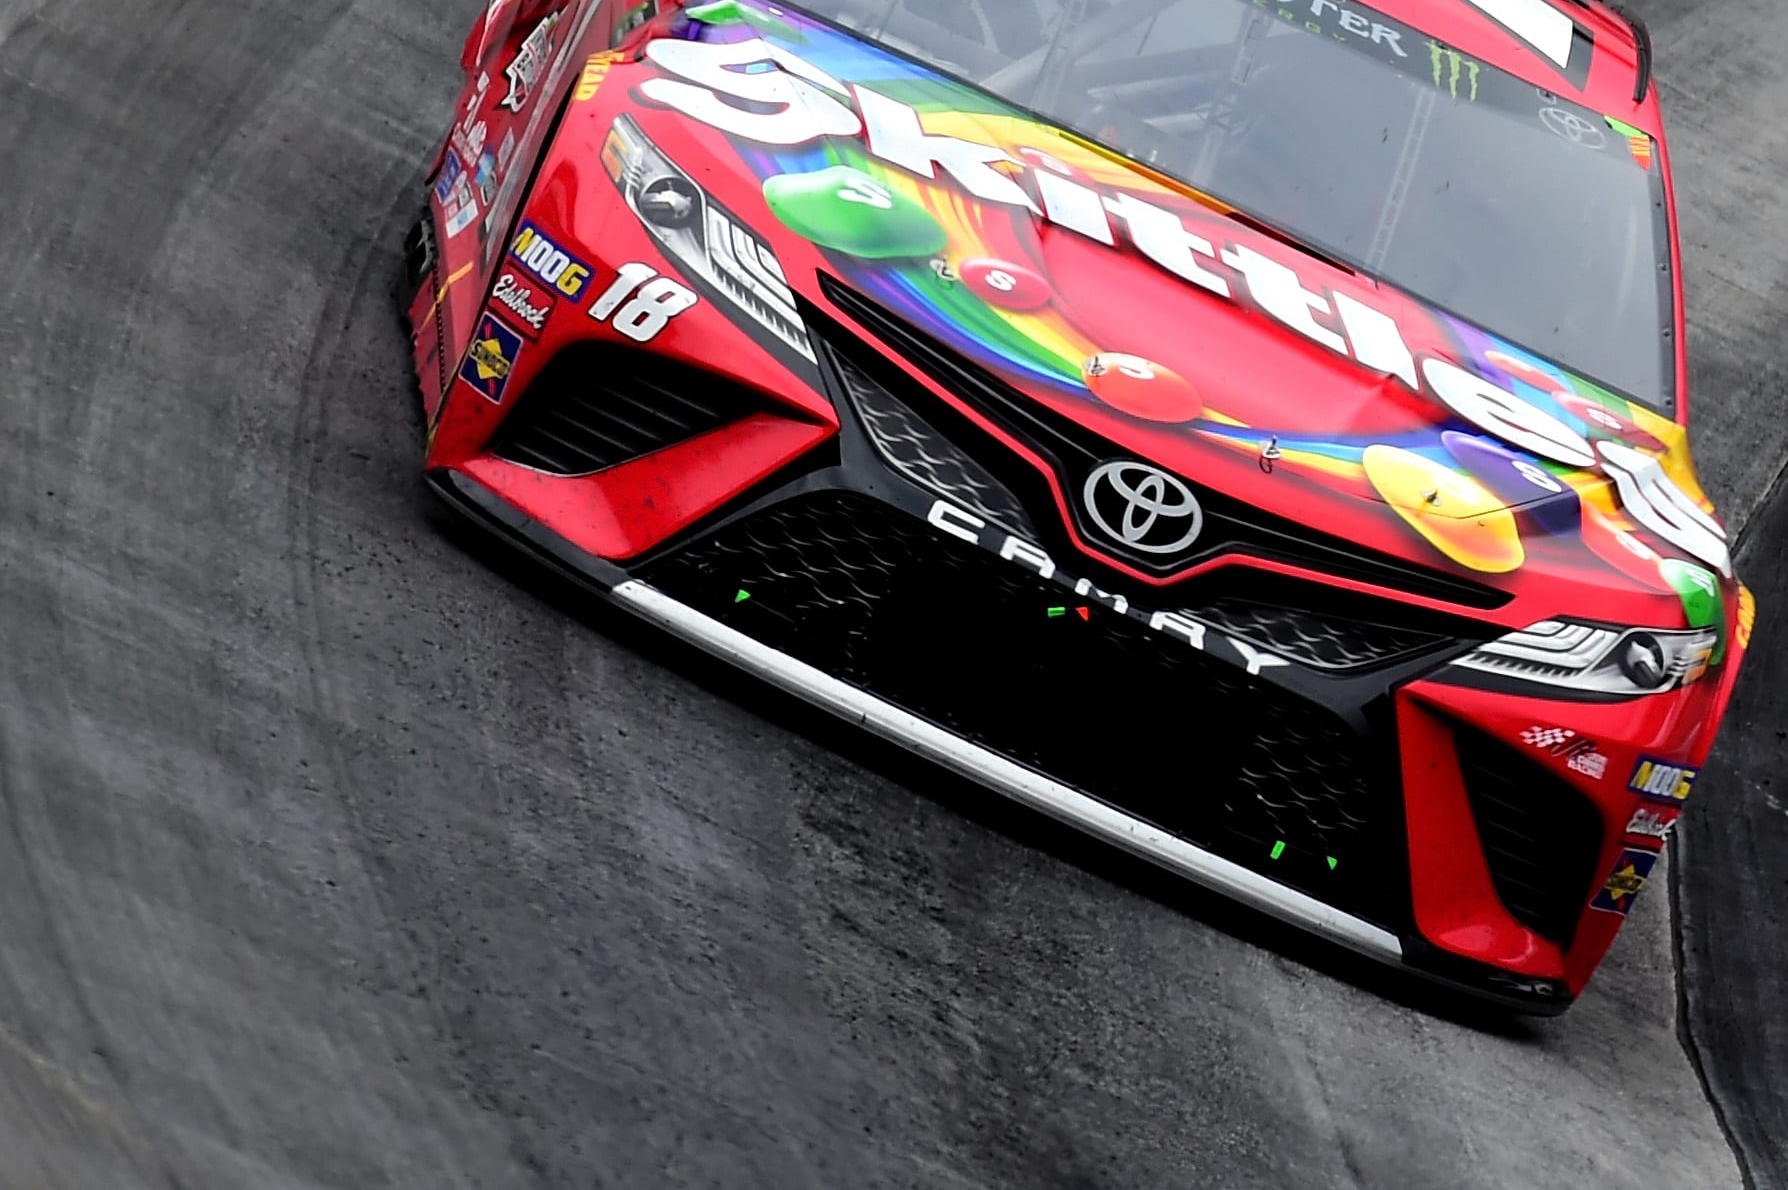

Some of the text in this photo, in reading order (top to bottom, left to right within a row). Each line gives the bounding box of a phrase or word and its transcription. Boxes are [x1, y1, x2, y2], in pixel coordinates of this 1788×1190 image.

[511, 227, 591, 297] MOOG
[588, 262, 699, 343] 18
[638, 38, 1732, 579] Skittles
[927, 499, 1291, 676] CAMRY
[1630, 760, 1697, 801] MOOG
